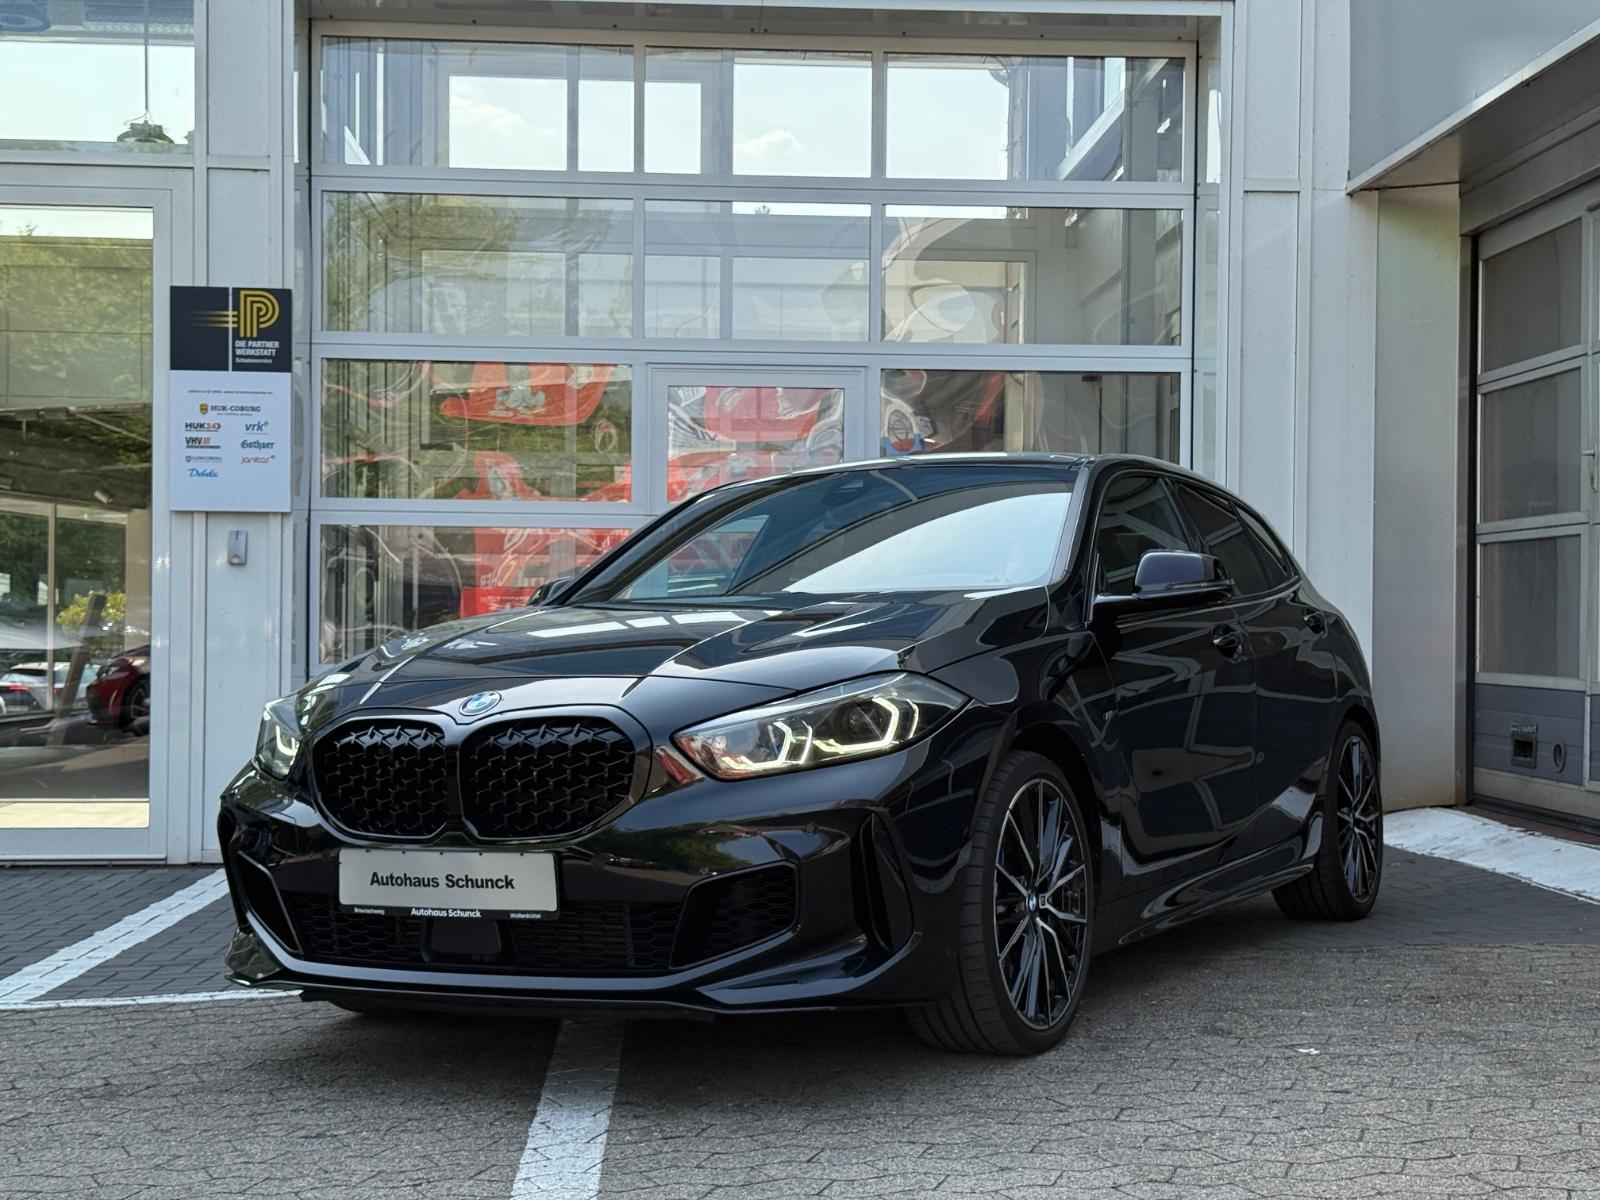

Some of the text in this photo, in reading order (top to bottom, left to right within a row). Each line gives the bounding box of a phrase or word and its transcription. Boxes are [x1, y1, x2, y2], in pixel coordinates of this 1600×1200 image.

[235, 340, 280, 349] DIE PARTNER
[235, 348, 276, 357] WERKSTATT
[210, 404, 262, 413] HUK-COBURG
[370, 871, 515, 889] Autohaus Schunck
[410, 907, 482, 918] Autohaus Schunck
